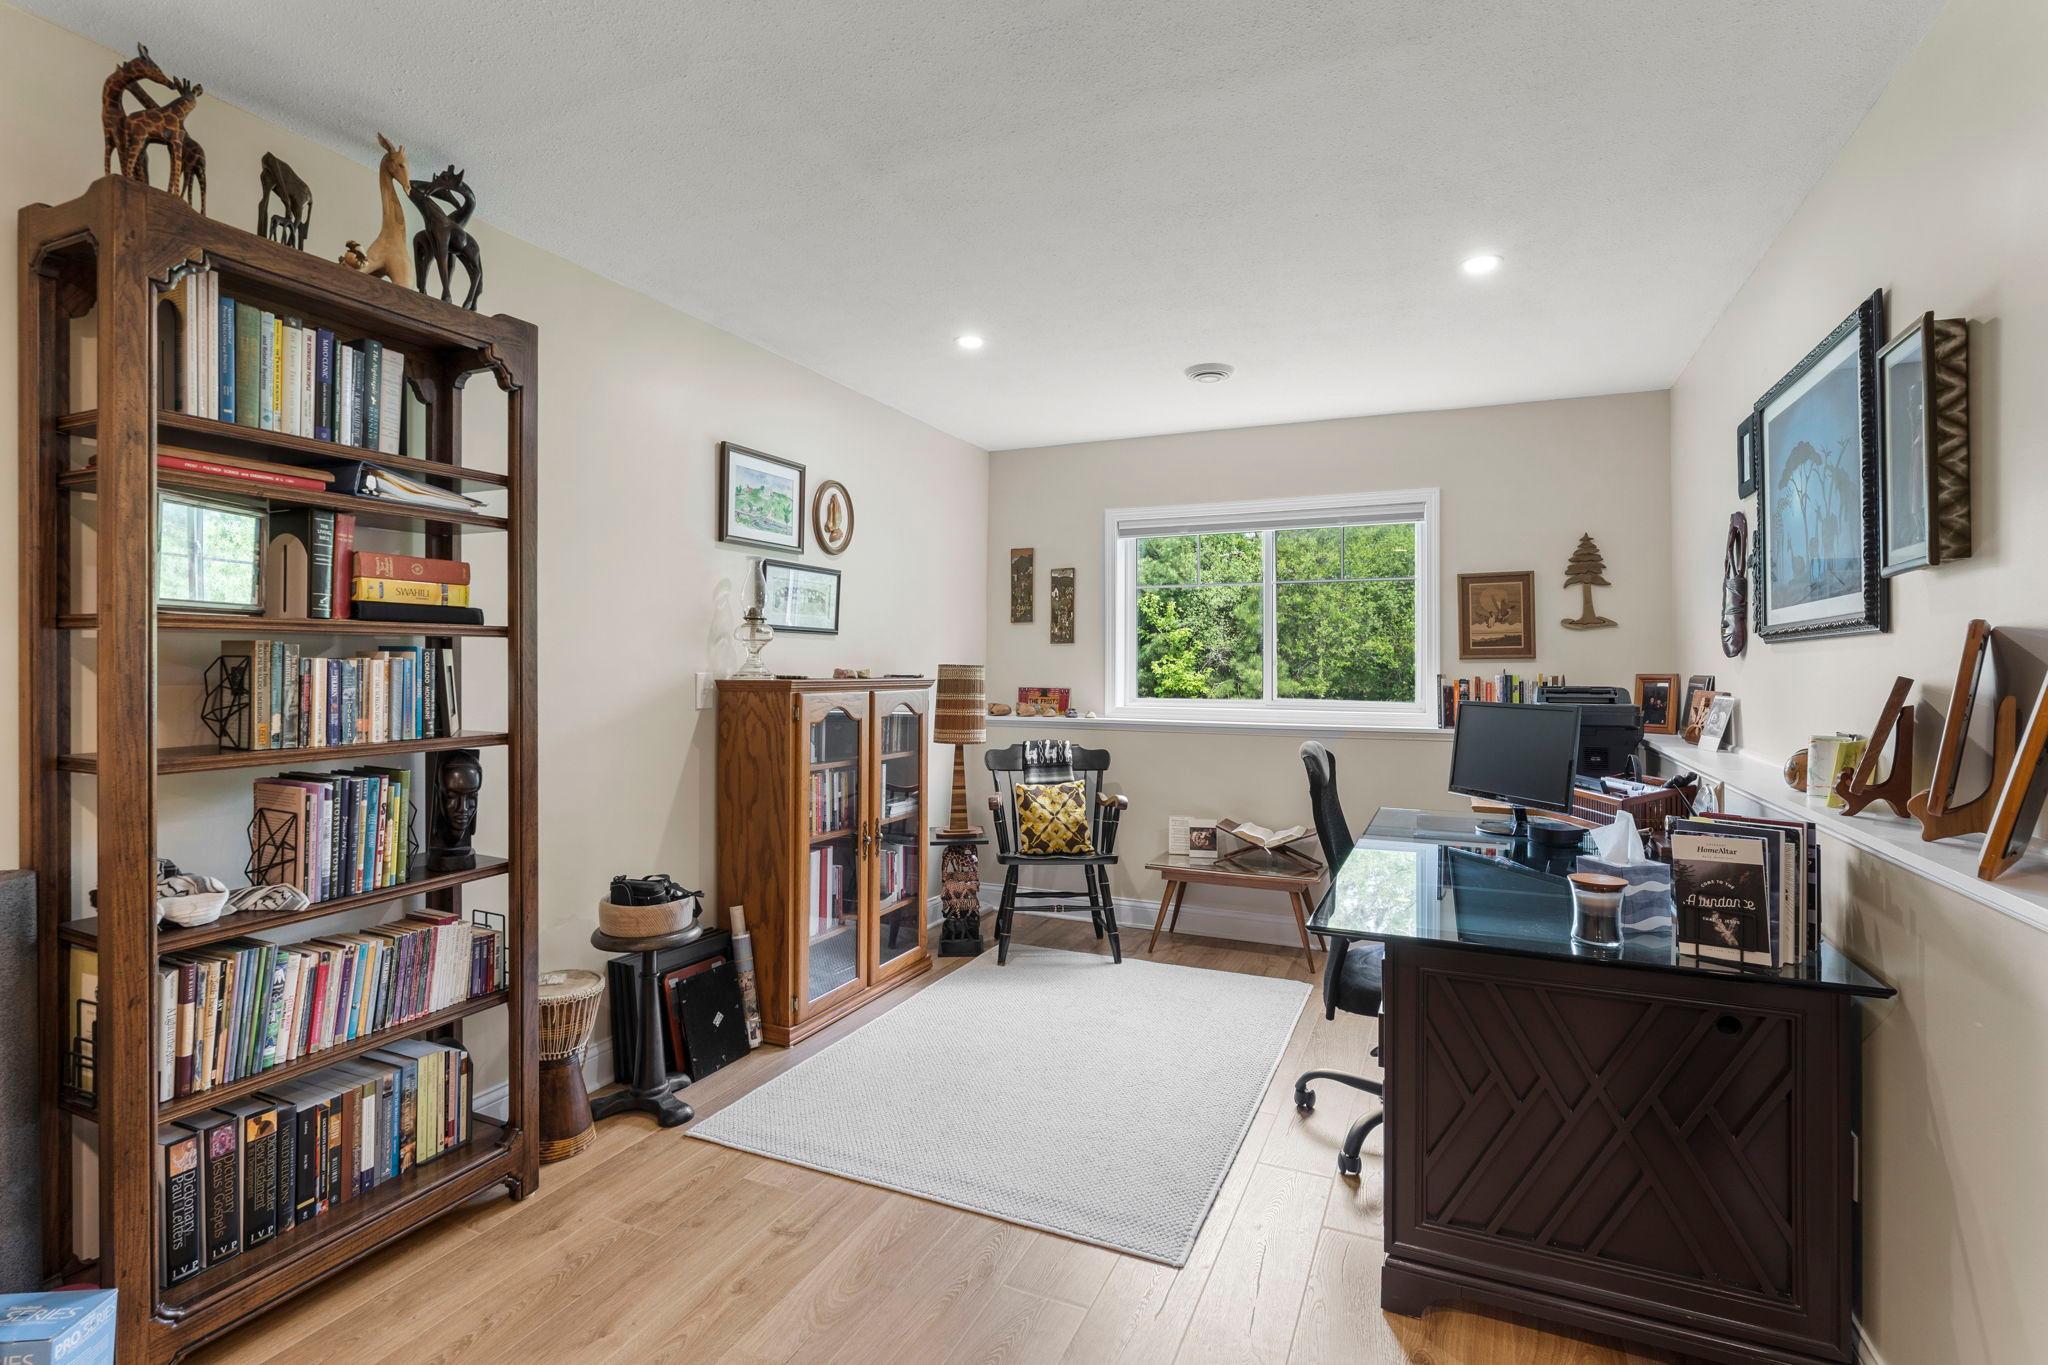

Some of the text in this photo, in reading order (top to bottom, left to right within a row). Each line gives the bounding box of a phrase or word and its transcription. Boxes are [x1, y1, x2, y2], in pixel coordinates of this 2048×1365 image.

[371, 350, 379, 361] The
[395, 587, 432, 598] SWAHILI
[333, 797, 341, 843] CROSSING
[1697, 846, 1738, 855] HomeAltar
[1700, 879, 1714, 888] COME
[224, 1153, 236, 1213] Dictionary
[256, 1138, 267, 1209] New Testament
[266, 1132, 277, 1211] Dictionary Later
[281, 1124, 290, 1204] WORLD RELIGIONS
[171, 1174, 185, 1250] Paul Letters
[181, 1169, 196, 1232] Dictionary
[211, 1158, 227, 1239] Jesus Gospels
[213, 1241, 238, 1258] IVP
[251, 1225, 274, 1242] IVP
[172, 1259, 199, 1277] IVP
[55, 1330, 81, 1361] PRO
